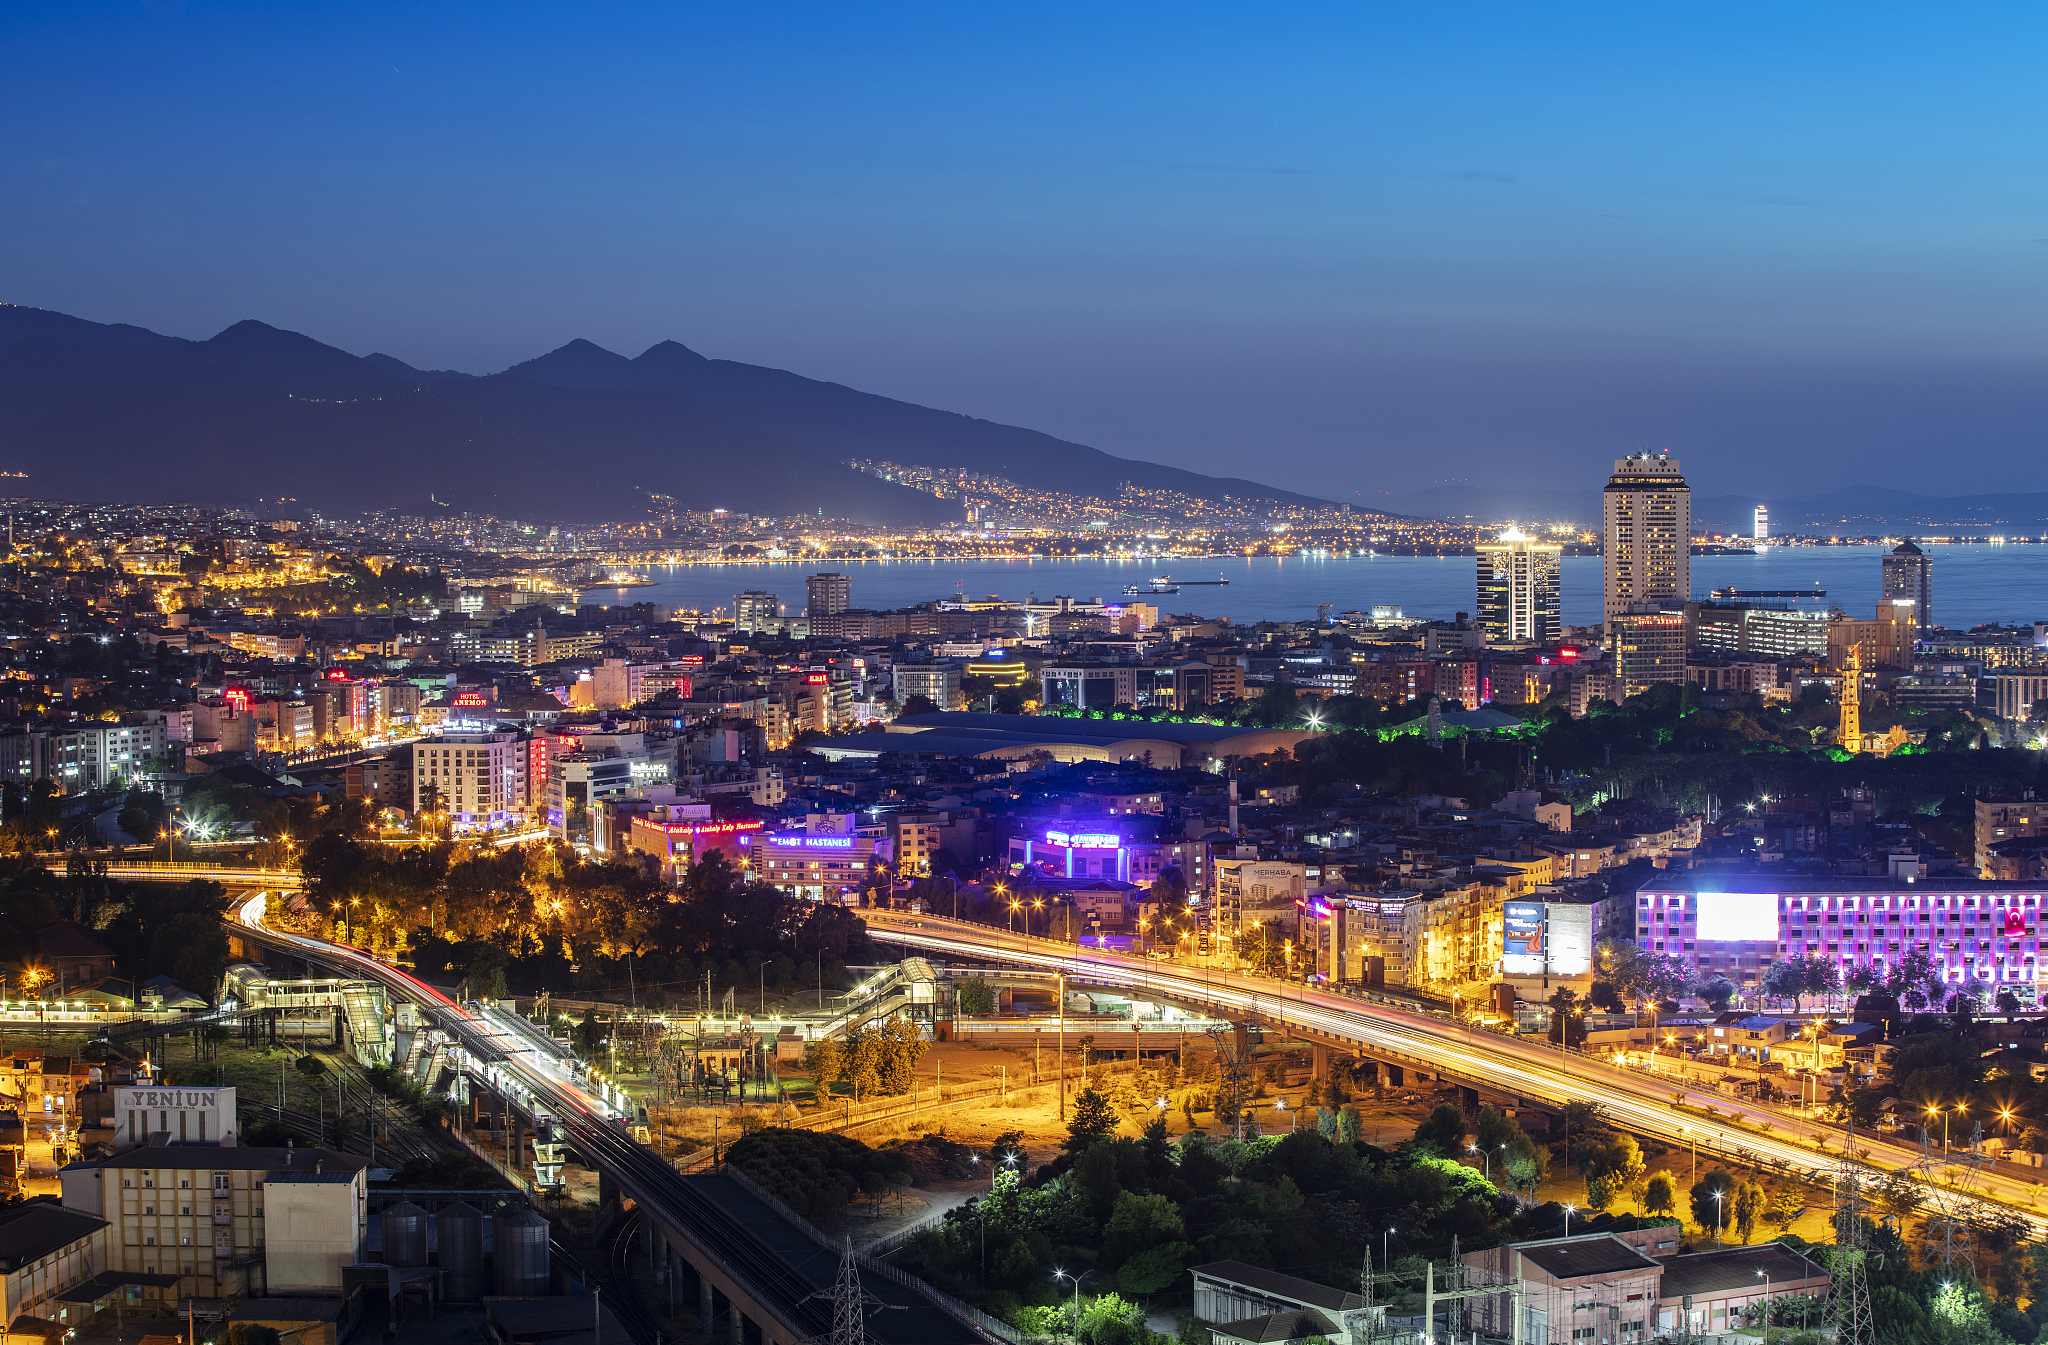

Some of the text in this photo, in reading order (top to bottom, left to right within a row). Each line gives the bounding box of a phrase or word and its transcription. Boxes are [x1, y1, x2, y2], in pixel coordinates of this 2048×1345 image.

[668, 826, 694, 835] Atakalp
[700, 821, 761, 833] Atakalp Kalp Hastanesi
[132, 1090, 215, 1106] YENİUN
